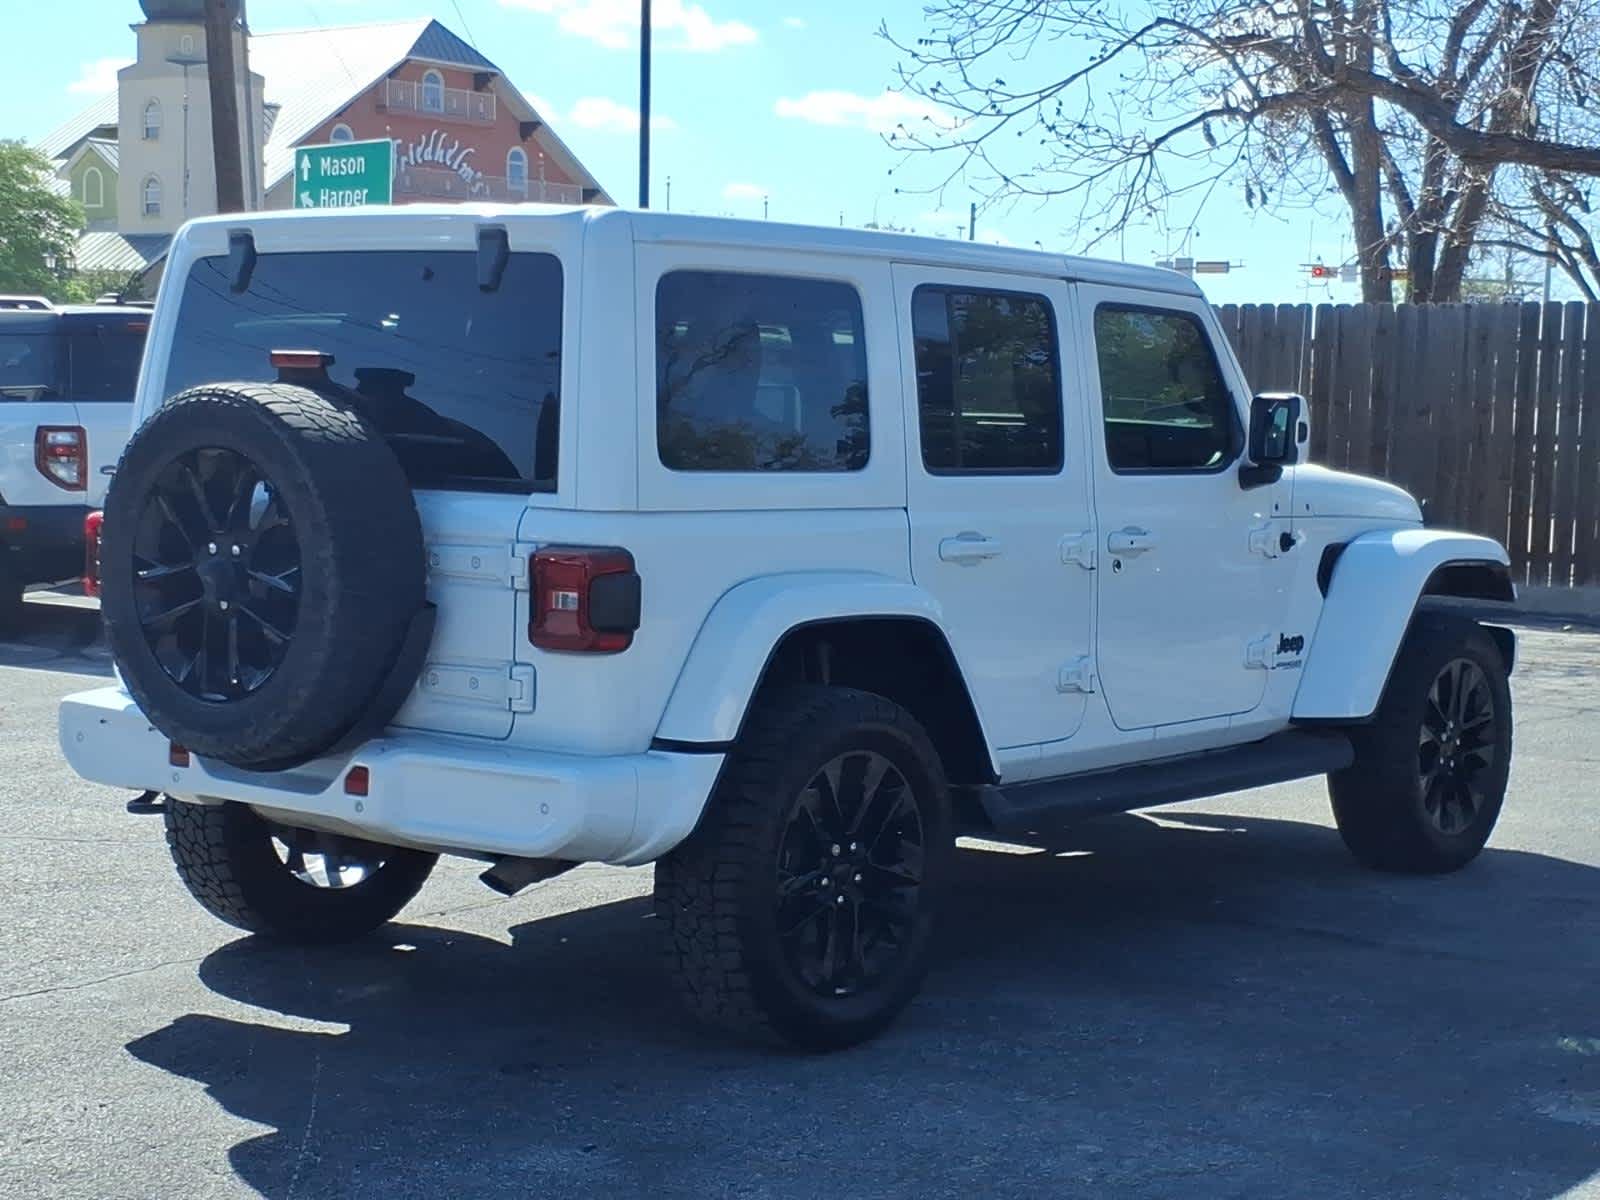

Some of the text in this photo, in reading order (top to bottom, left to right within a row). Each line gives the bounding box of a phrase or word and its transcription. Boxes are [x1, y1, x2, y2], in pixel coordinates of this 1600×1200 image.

[320, 156, 365, 176] Mason
[319, 188, 368, 208] Harper
[1276, 633, 1304, 655] Jeep
